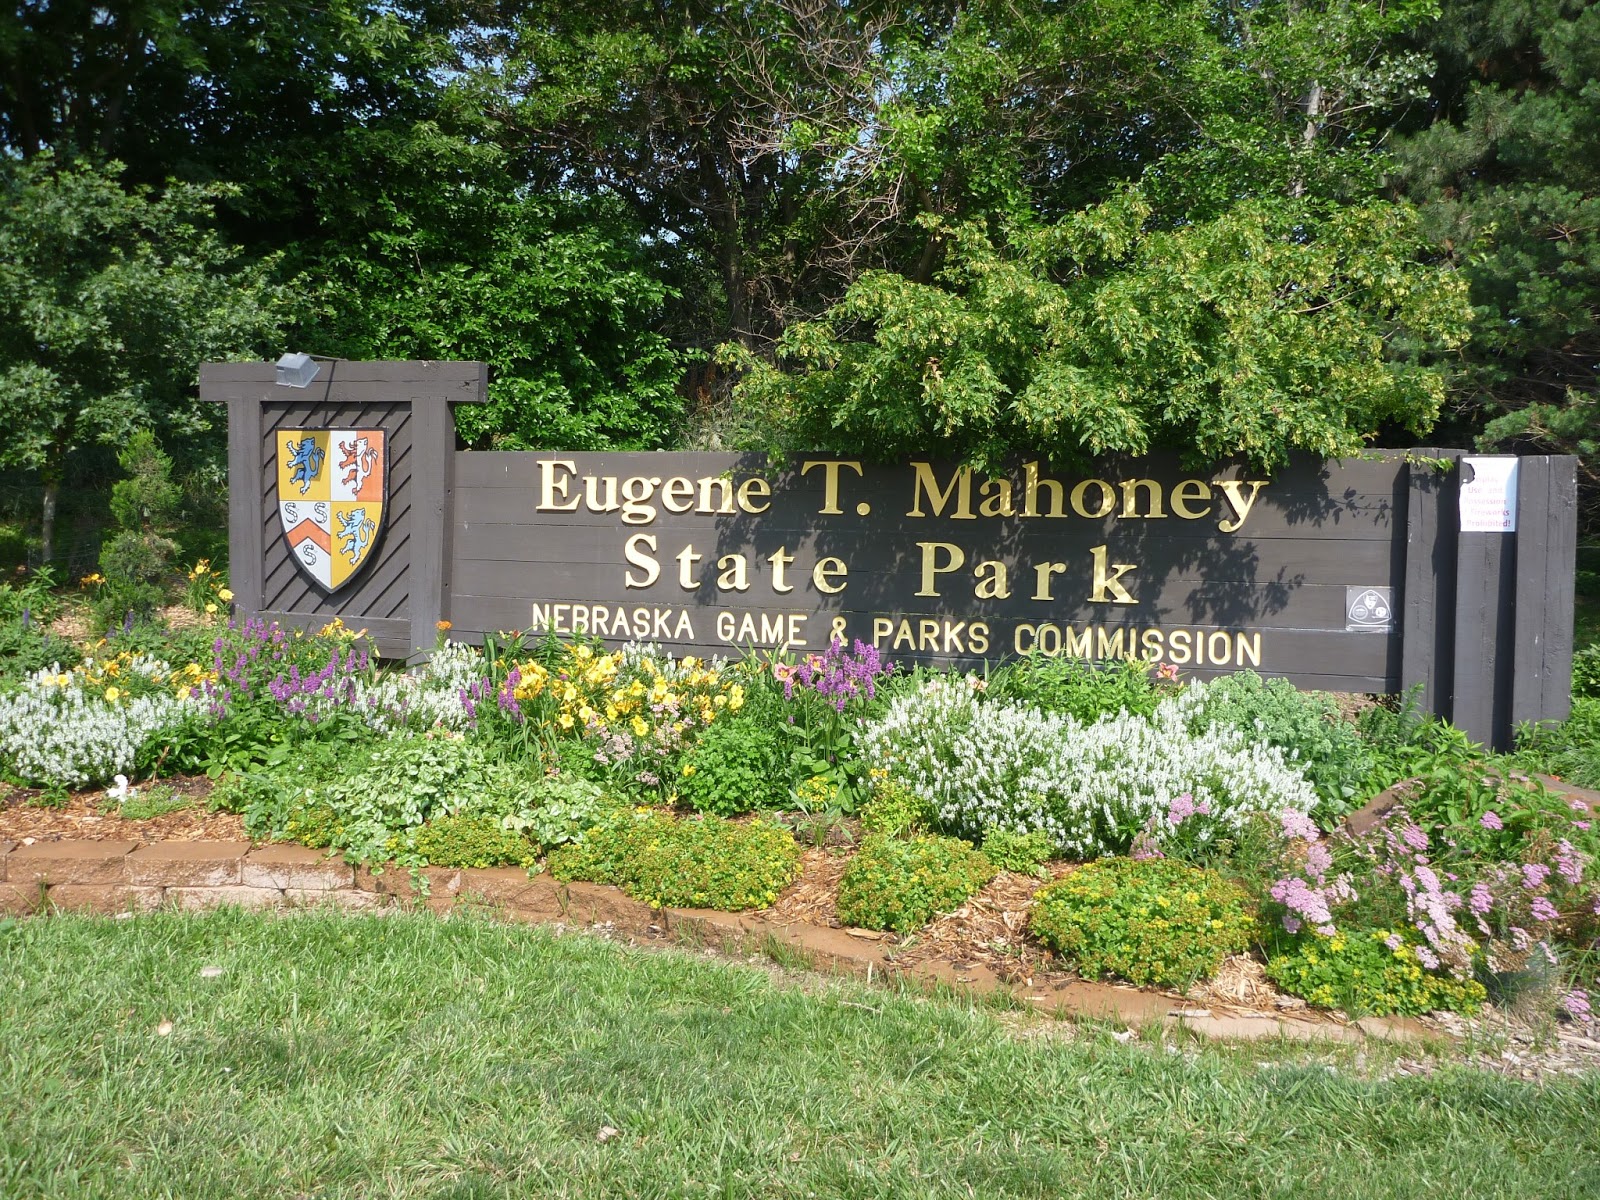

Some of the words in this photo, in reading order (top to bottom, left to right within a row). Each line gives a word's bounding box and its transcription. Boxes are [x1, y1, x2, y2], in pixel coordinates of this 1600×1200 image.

[536, 460, 771, 525] Eugene
[801, 460, 871, 516] T.
[906, 460, 1270, 533] Mahoney
[624, 533, 848, 594] State
[914, 542, 1139, 604] Park
[532, 603, 695, 640] NEBRASKA
[716, 611, 808, 646] GAME
[829, 616, 849, 648] &
[873, 617, 990, 654] PARKS
[1014, 622, 1261, 667] COMMISSION
